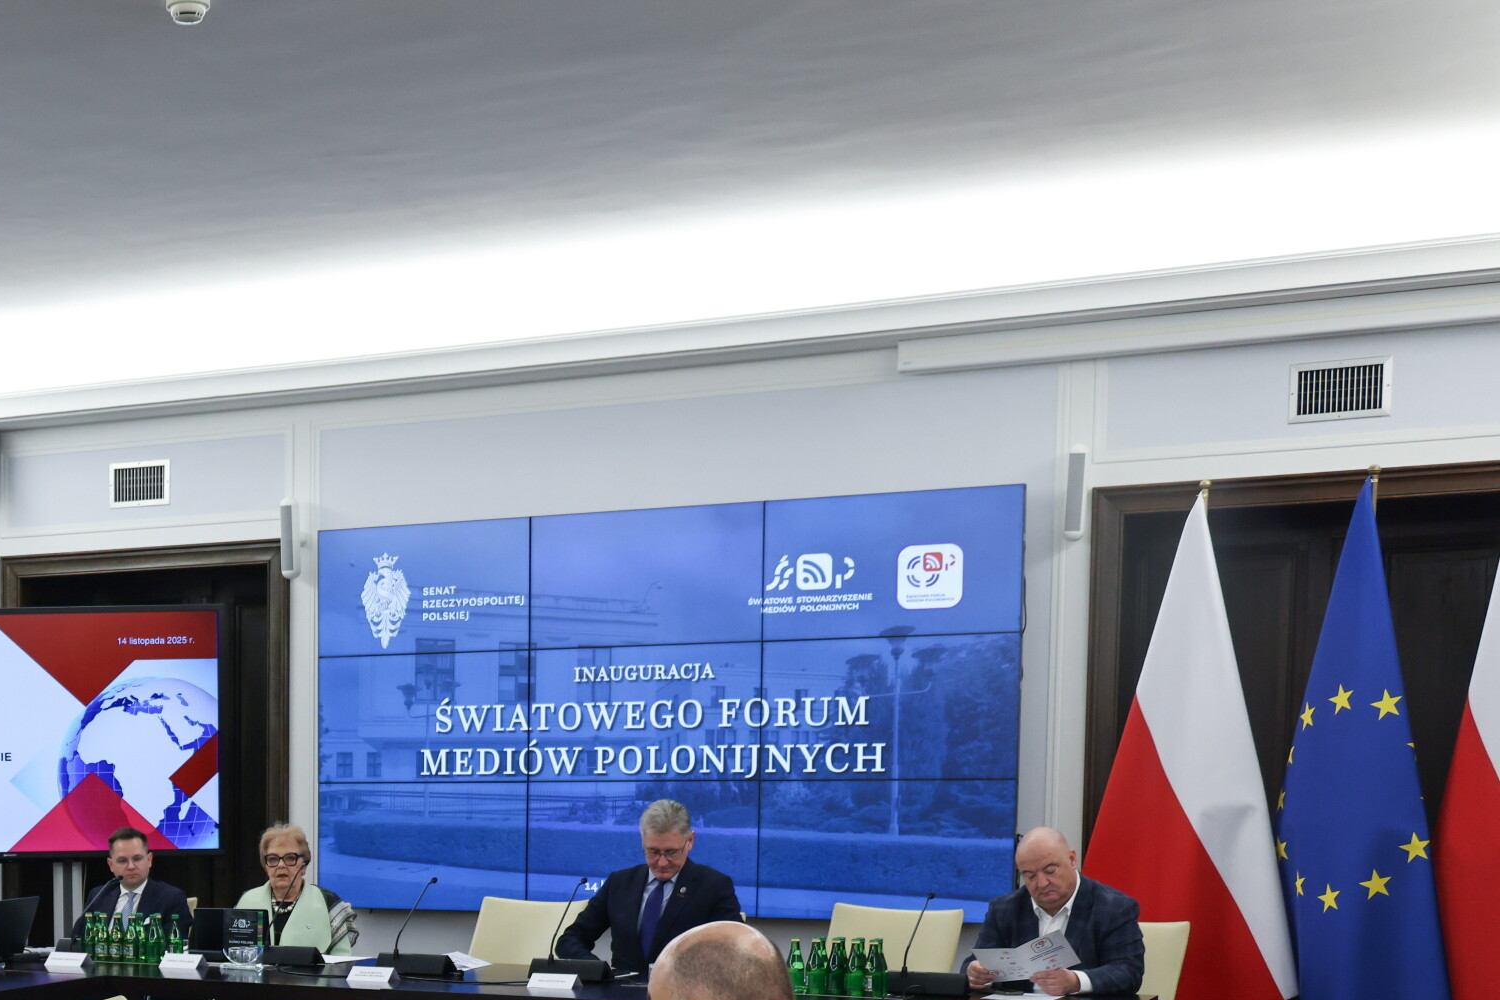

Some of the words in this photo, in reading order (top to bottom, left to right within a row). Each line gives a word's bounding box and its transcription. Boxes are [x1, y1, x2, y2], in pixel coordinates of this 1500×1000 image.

[422, 585, 457, 596] SENAT
[422, 595, 525, 609] RZECZYPOSPOLITEJ
[796, 592, 873, 604] STOWARZYSZENIE
[761, 604, 797, 614] MEDIÓW
[800, 602, 860, 613] POLONIJNYCH
[422, 611, 470, 622] POLSKIEJ
[117, 637, 127, 645] 14
[129, 636, 165, 646] listopada
[167, 636, 187, 645] 2025
[574, 662, 715, 682] INAUGURACJA
[435, 697, 703, 733] ŚWIATOWEGO
[718, 696, 870, 728] FORUM
[420, 739, 583, 776] MEDIÓW
[593, 742, 886, 778] POLONIJNYCH
[584, 882, 598, 893] 14
